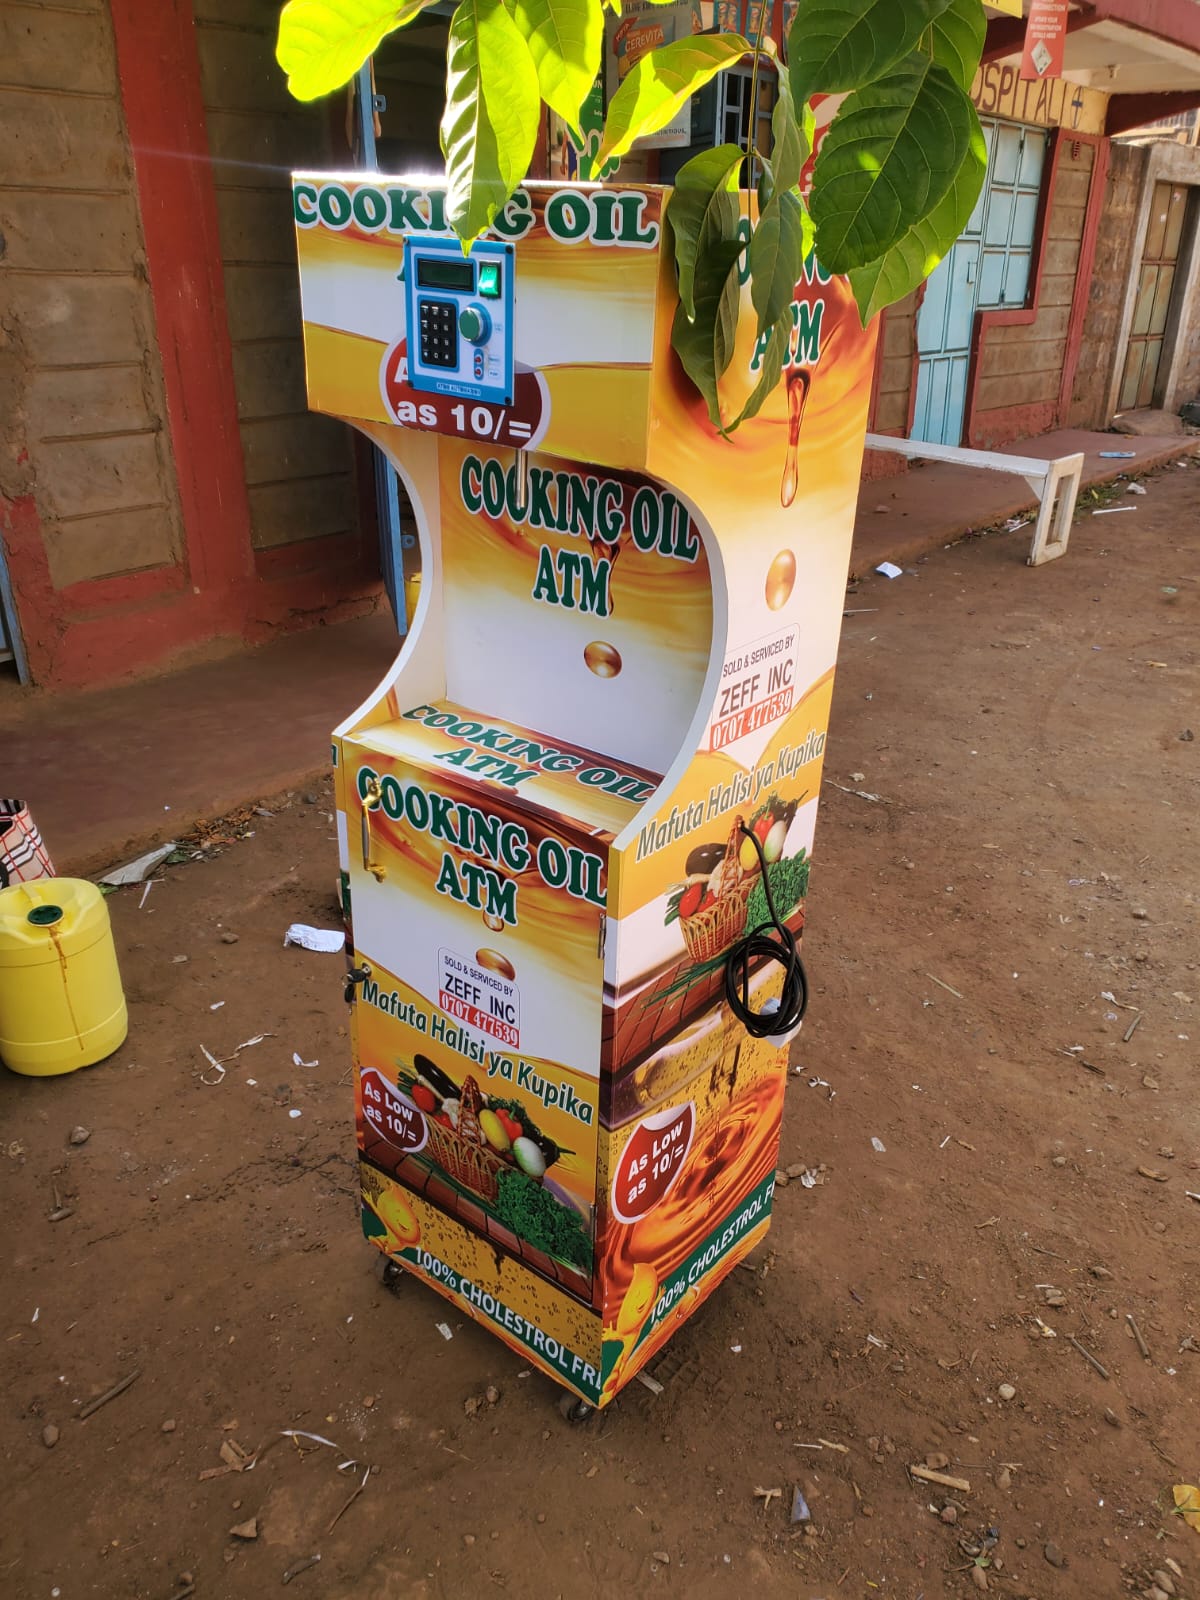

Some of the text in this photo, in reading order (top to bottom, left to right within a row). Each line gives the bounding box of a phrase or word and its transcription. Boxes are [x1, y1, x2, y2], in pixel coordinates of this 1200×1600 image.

[625, 28, 664, 52] CEREVITA
[967, 62, 1058, 123] OSPITAL
[293, 184, 657, 246] COOKIG OIL
[397, 401, 532, 440] as 10/=
[461, 455, 698, 561] COOKING OIL
[533, 546, 610, 617] ATM
[723, 634, 794, 677] SOLD & SERVICED BY
[719, 659, 793, 718] ZEFF INC
[713, 691, 792, 749] 0707 477539
[402, 705, 655, 802] COOKING OIL
[434, 748, 538, 787] ATM
[636, 731, 826, 862] Mafuta Halisi ya Kupika
[358, 767, 607, 906] COOKING OIL
[437, 854, 517, 924] ATM
[445, 956, 513, 997] SOLD & SERVICED BY
[445, 973, 515, 1024] ZEFF INC
[442, 993, 517, 1046] 0707 477539
[362, 979, 593, 1124] Mafuta Halisi ya Kupika
[367, 1105, 416, 1141] as 10/=
[628, 1144, 684, 1203] as 10/=
[651, 1276, 685, 1323] 100%
[688, 1200, 762, 1283] CHOLESTROL
[415, 1246, 457, 1288] 100%
[460, 1278, 568, 1368] CHOLESTROL
